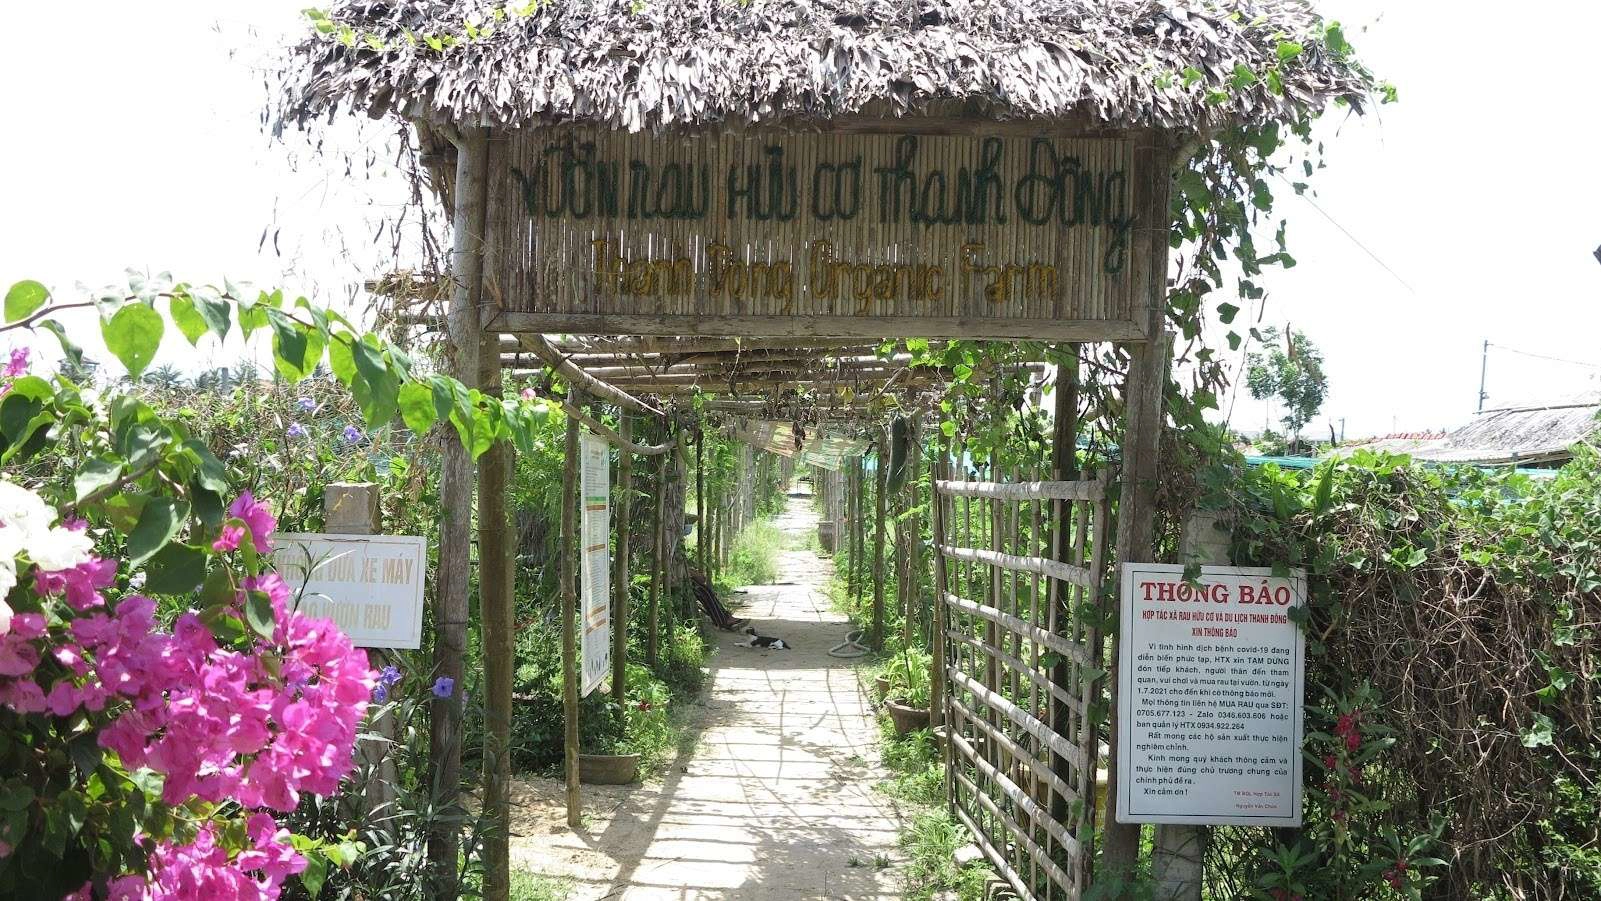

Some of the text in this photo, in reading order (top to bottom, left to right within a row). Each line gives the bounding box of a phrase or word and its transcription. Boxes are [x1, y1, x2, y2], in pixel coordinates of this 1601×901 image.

[810, 240, 945, 314] Organic
[961, 242, 1057, 303] Farm
[1239, 580, 1290, 605] BÁO
[1179, 611, 1191, 620] RAU
[1249, 615, 1268, 623] THANH
